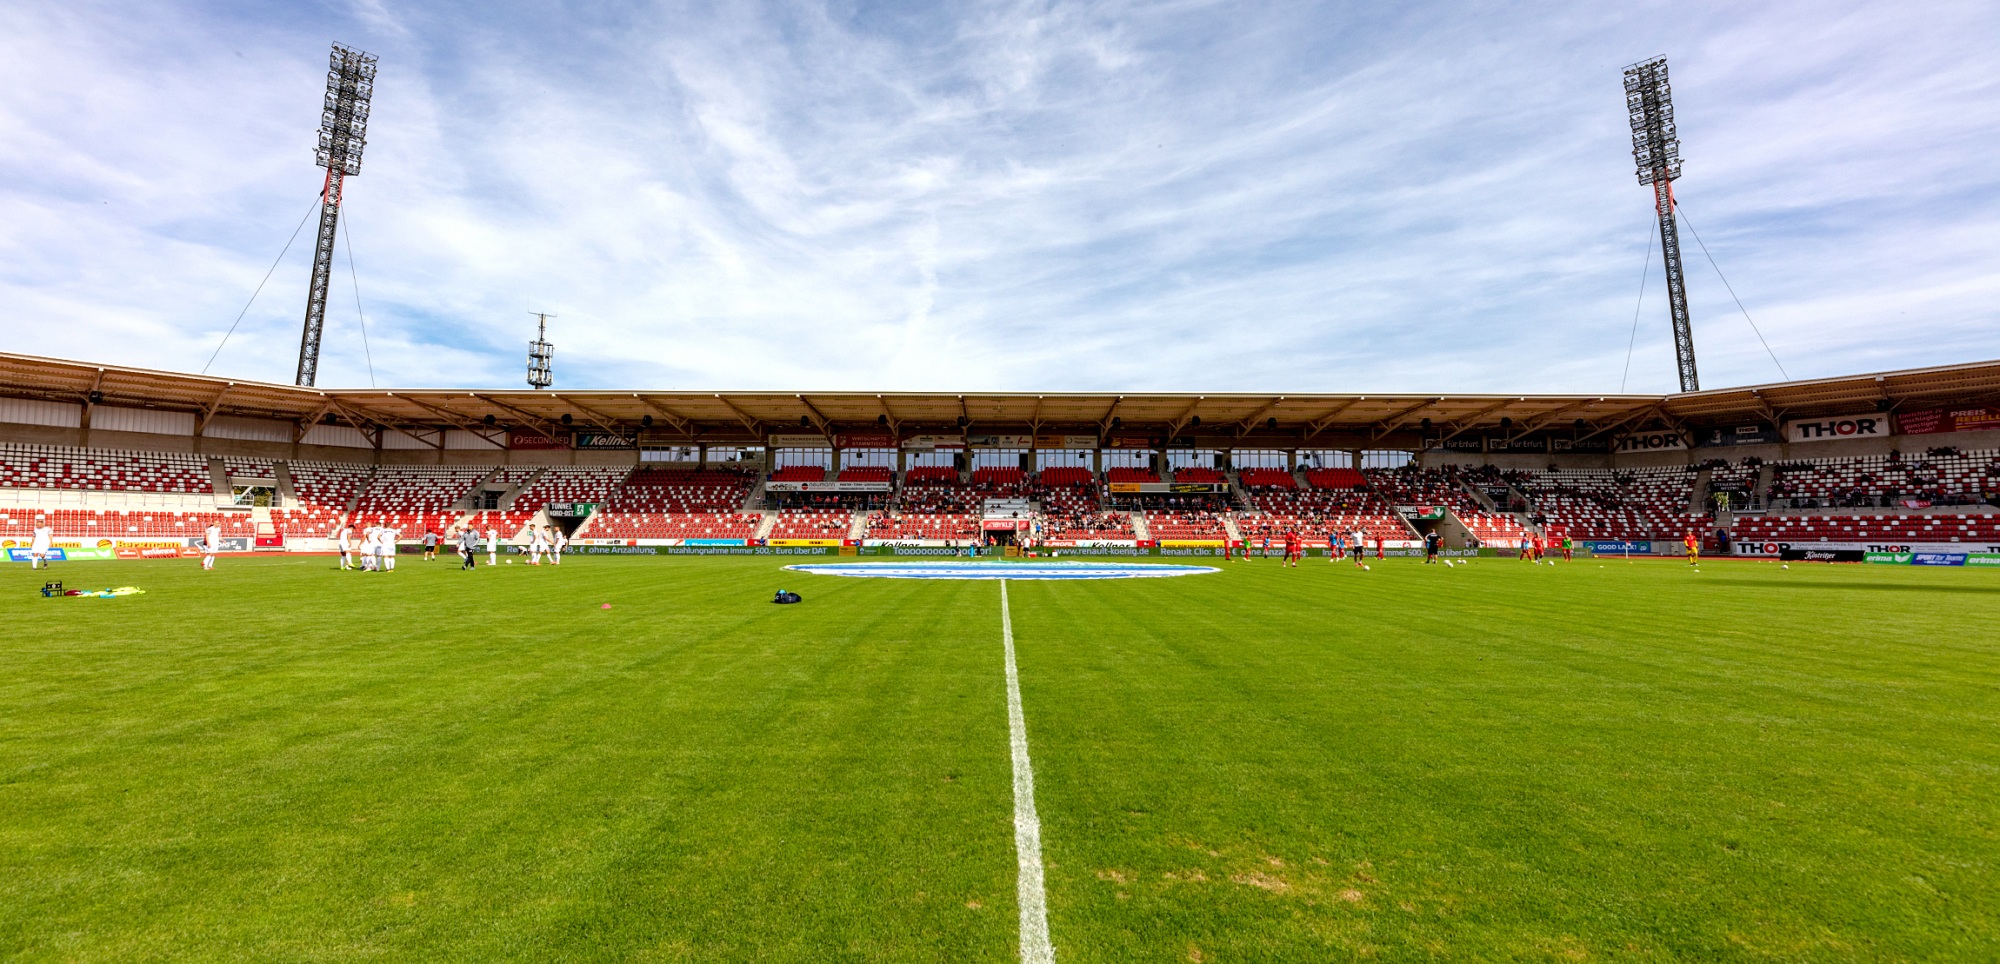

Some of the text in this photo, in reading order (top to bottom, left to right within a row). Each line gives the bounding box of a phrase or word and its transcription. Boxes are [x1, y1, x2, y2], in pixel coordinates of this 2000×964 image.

[1950, 408, 1986, 418] PREIS
[1900, 414, 1942, 424] unschlagbar
[1904, 420, 1938, 430] günstigen
[1908, 426, 1936, 434] Preisen!
[1621, 434, 1680, 450] THOR
[611, 546, 658, 556] Anzahlung.
[668, 546, 729, 556] Inzahlungnahme
[756, 547, 773, 555] 500,-
[1804, 551, 1836, 560] Köstritzer
